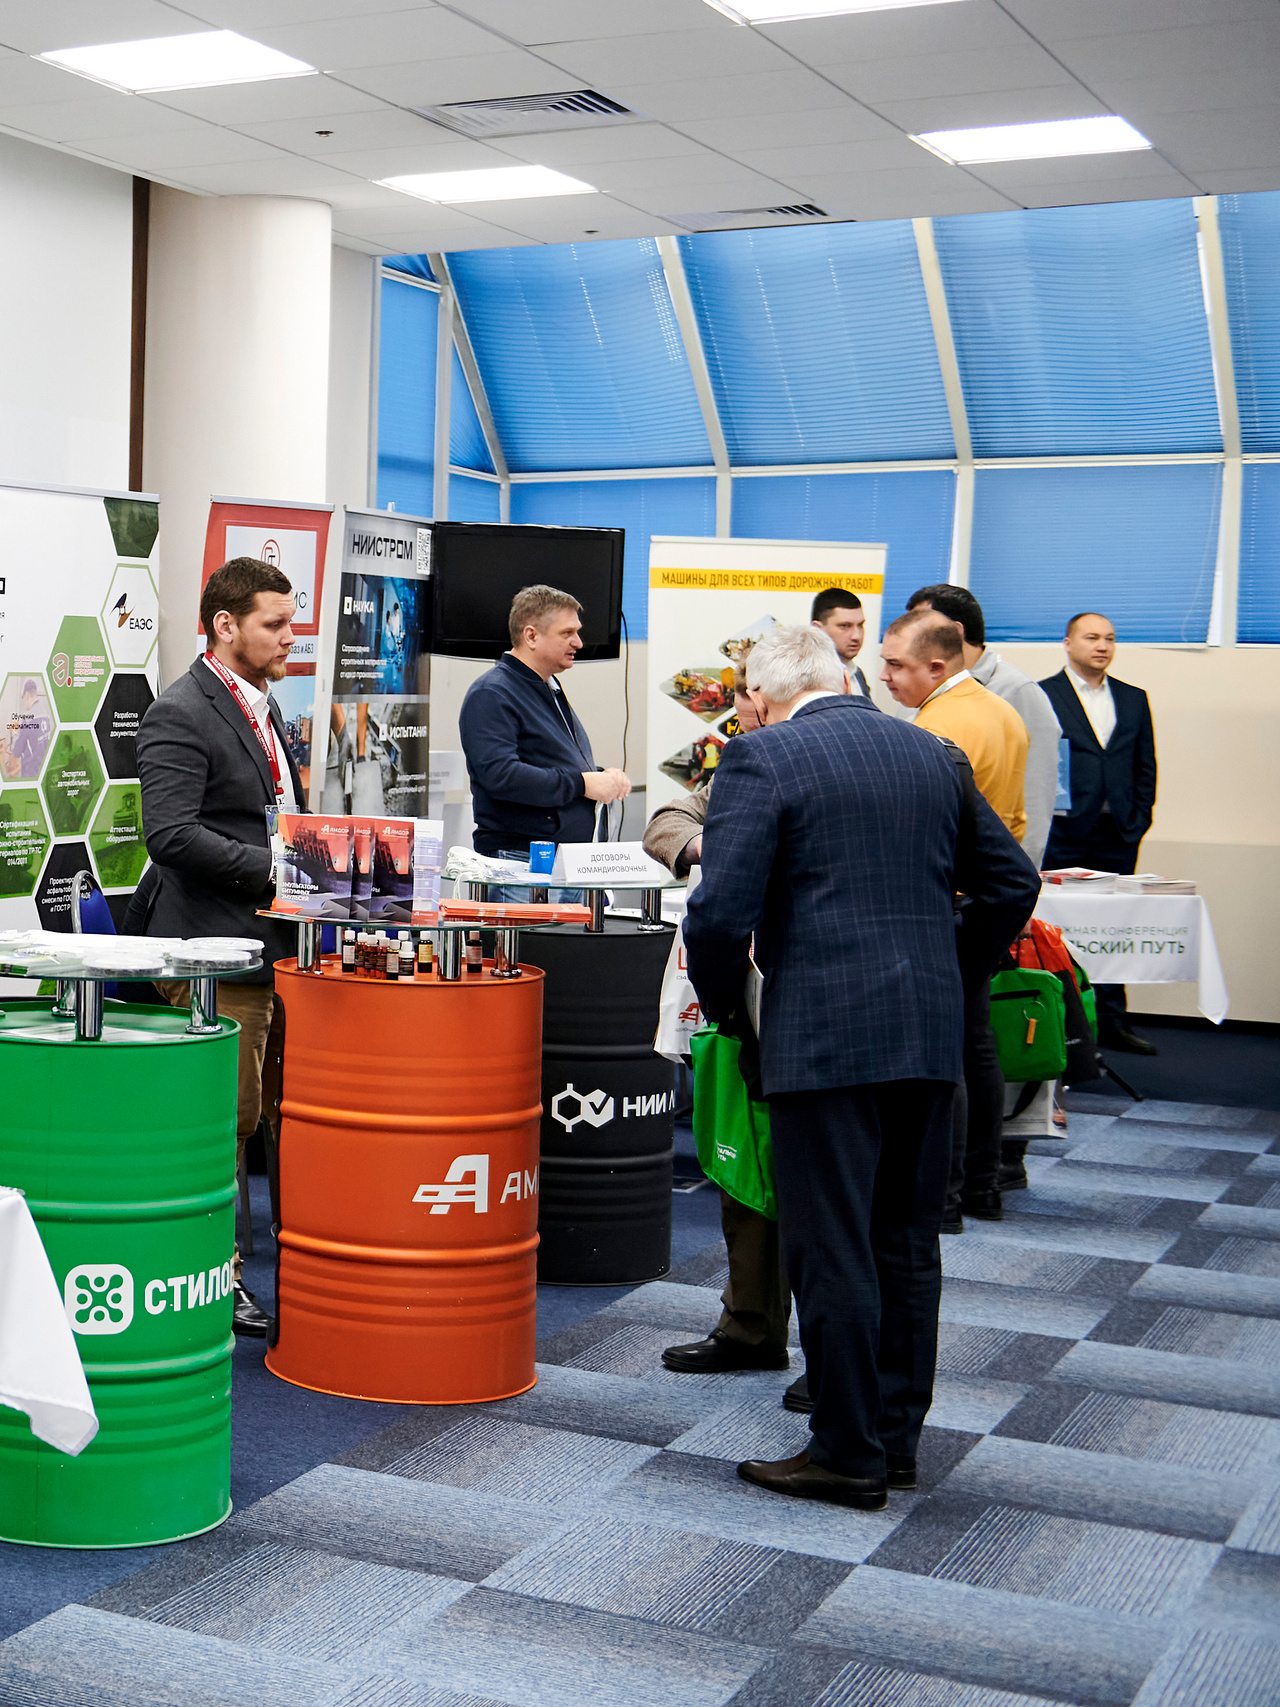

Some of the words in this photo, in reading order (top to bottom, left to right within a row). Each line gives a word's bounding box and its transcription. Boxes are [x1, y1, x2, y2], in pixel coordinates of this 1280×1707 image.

[352, 533, 413, 560] НИИСТРОМ
[662, 572, 707, 585] МАШИНЫ
[709, 573, 729, 587] ДЛЯ
[732, 574, 755, 587] ВСЕХ
[757, 575, 787, 587] ТИПОВ
[789, 577, 843, 590] ДОРОЖНЫХ
[845, 578, 873, 590] РАБОТ
[352, 600, 374, 613] НАУКА
[130, 618, 153, 630] ЕАЭС
[590, 853, 631, 863] ДОГОВОРЫ
[577, 865, 648, 875] КОМАНДИРОВОЧНЫЕ
[1055, 925, 1098, 936] ЖНАЯ
[1101, 926, 1189, 937] КОНФЕРЕНЦИЯ
[1069, 937, 1134, 954] ЬСКИЙ
[1141, 940, 1186, 954] ПУТЬ
[623, 1092, 667, 1118] НИИ
[500, 1165, 539, 1204] АМ
